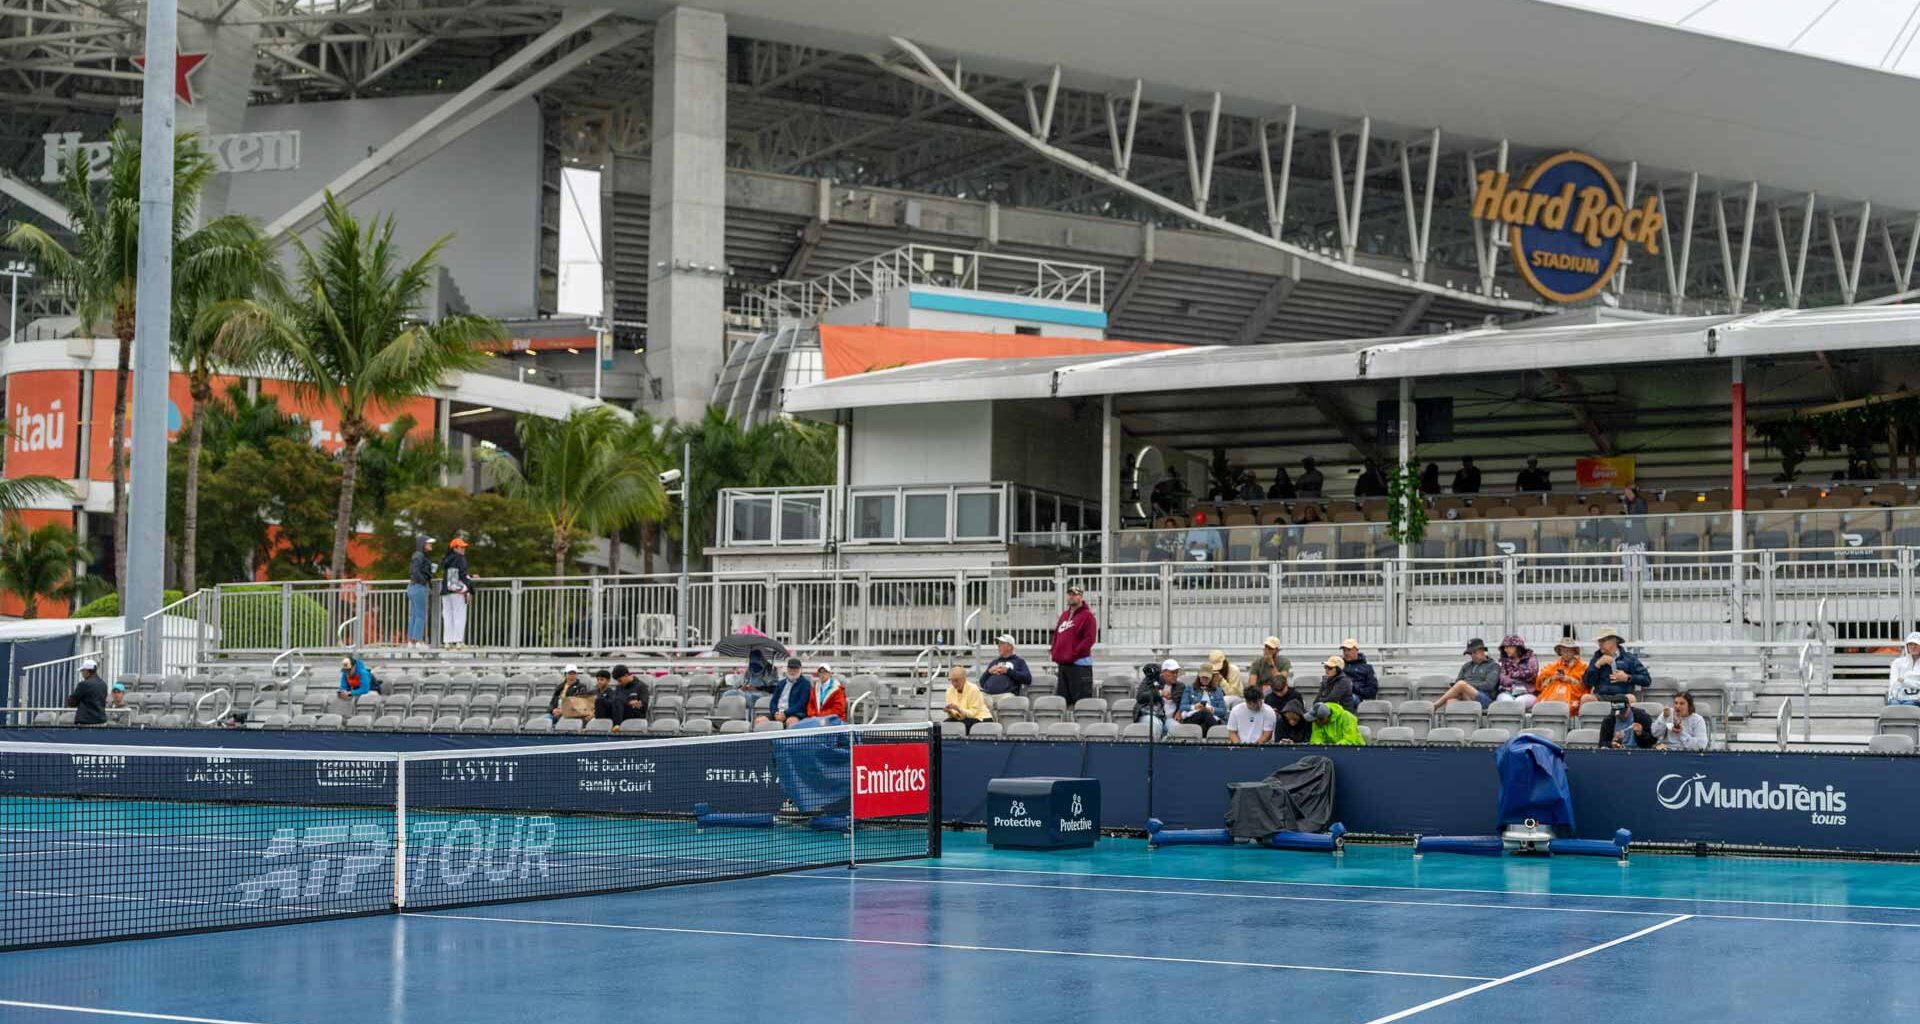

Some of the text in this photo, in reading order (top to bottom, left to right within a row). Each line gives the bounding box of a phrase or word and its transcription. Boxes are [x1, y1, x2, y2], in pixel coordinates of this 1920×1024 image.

[1471, 168, 1665, 255] Hard Rock
[1531, 250, 1600, 275] STADIUM
[576, 757, 599, 772] The
[705, 768, 759, 783] STELLA
[855, 763, 926, 795] Emirates
[579, 778, 652, 795] Family Court
[1694, 781, 1847, 813] MundoTênis
[994, 816, 1042, 828] Protective
[1060, 816, 1092, 833] Protective
[1811, 812, 1847, 826] tours
[230, 815, 556, 904] ATP TOUR
